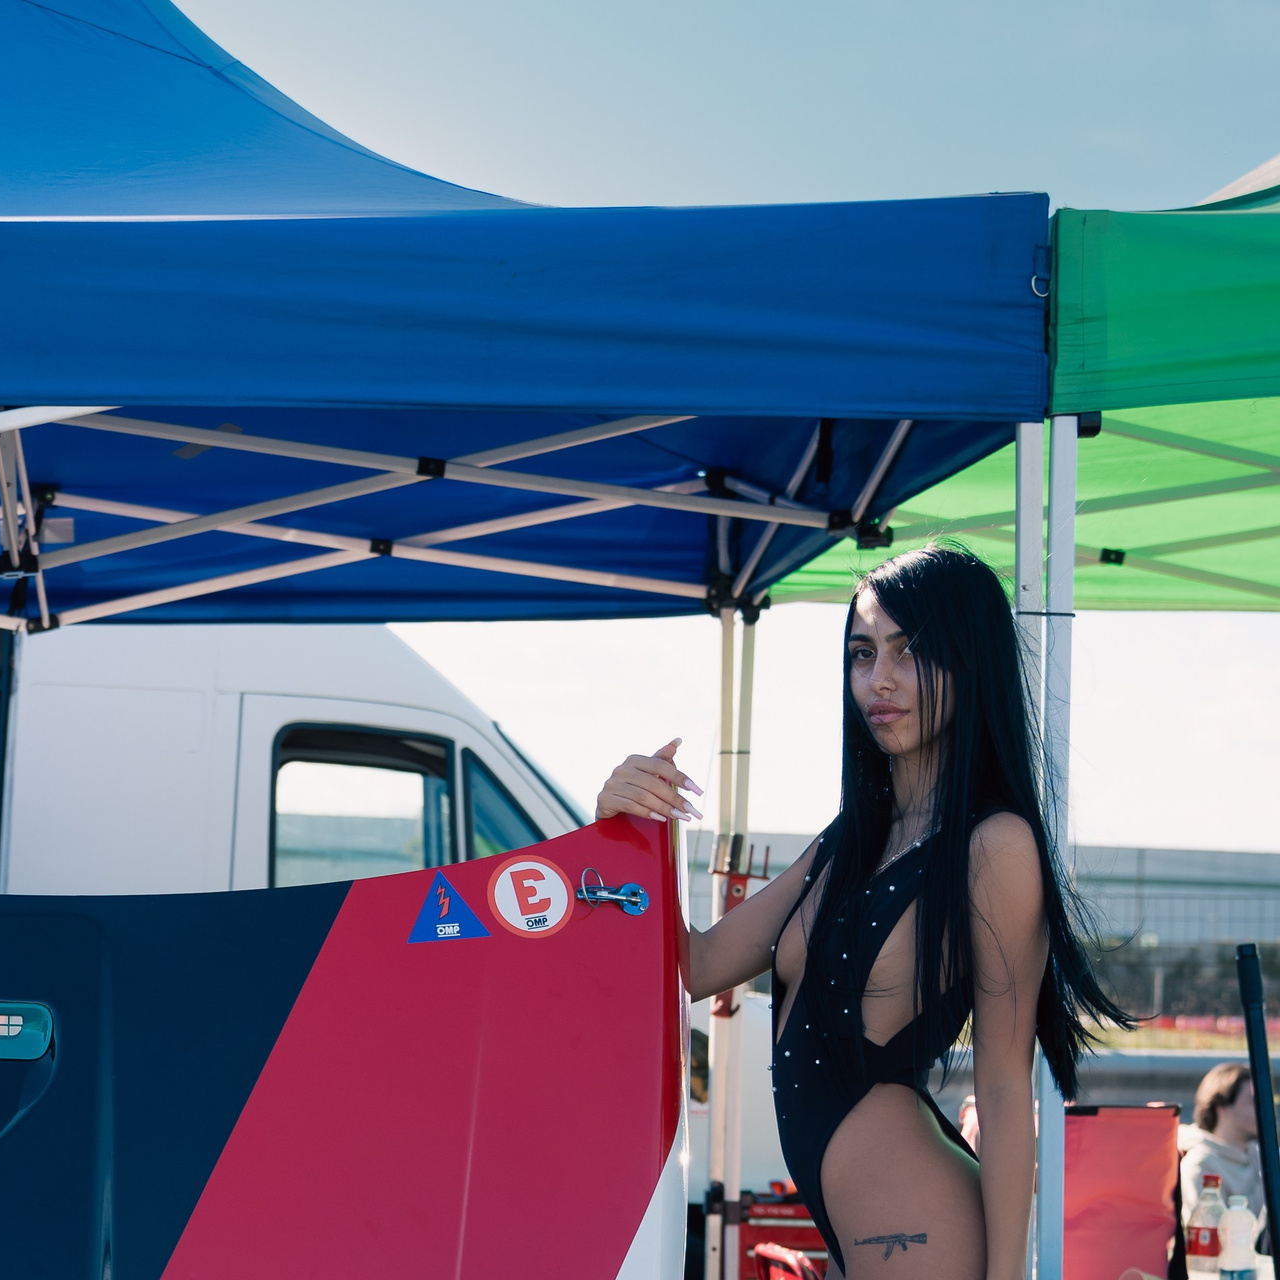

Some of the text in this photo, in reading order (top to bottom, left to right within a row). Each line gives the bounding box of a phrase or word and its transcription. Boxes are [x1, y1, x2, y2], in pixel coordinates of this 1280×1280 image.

[509, 868, 552, 917] E
[525, 917, 549, 928] OMP
[436, 925, 461, 935] OMP
